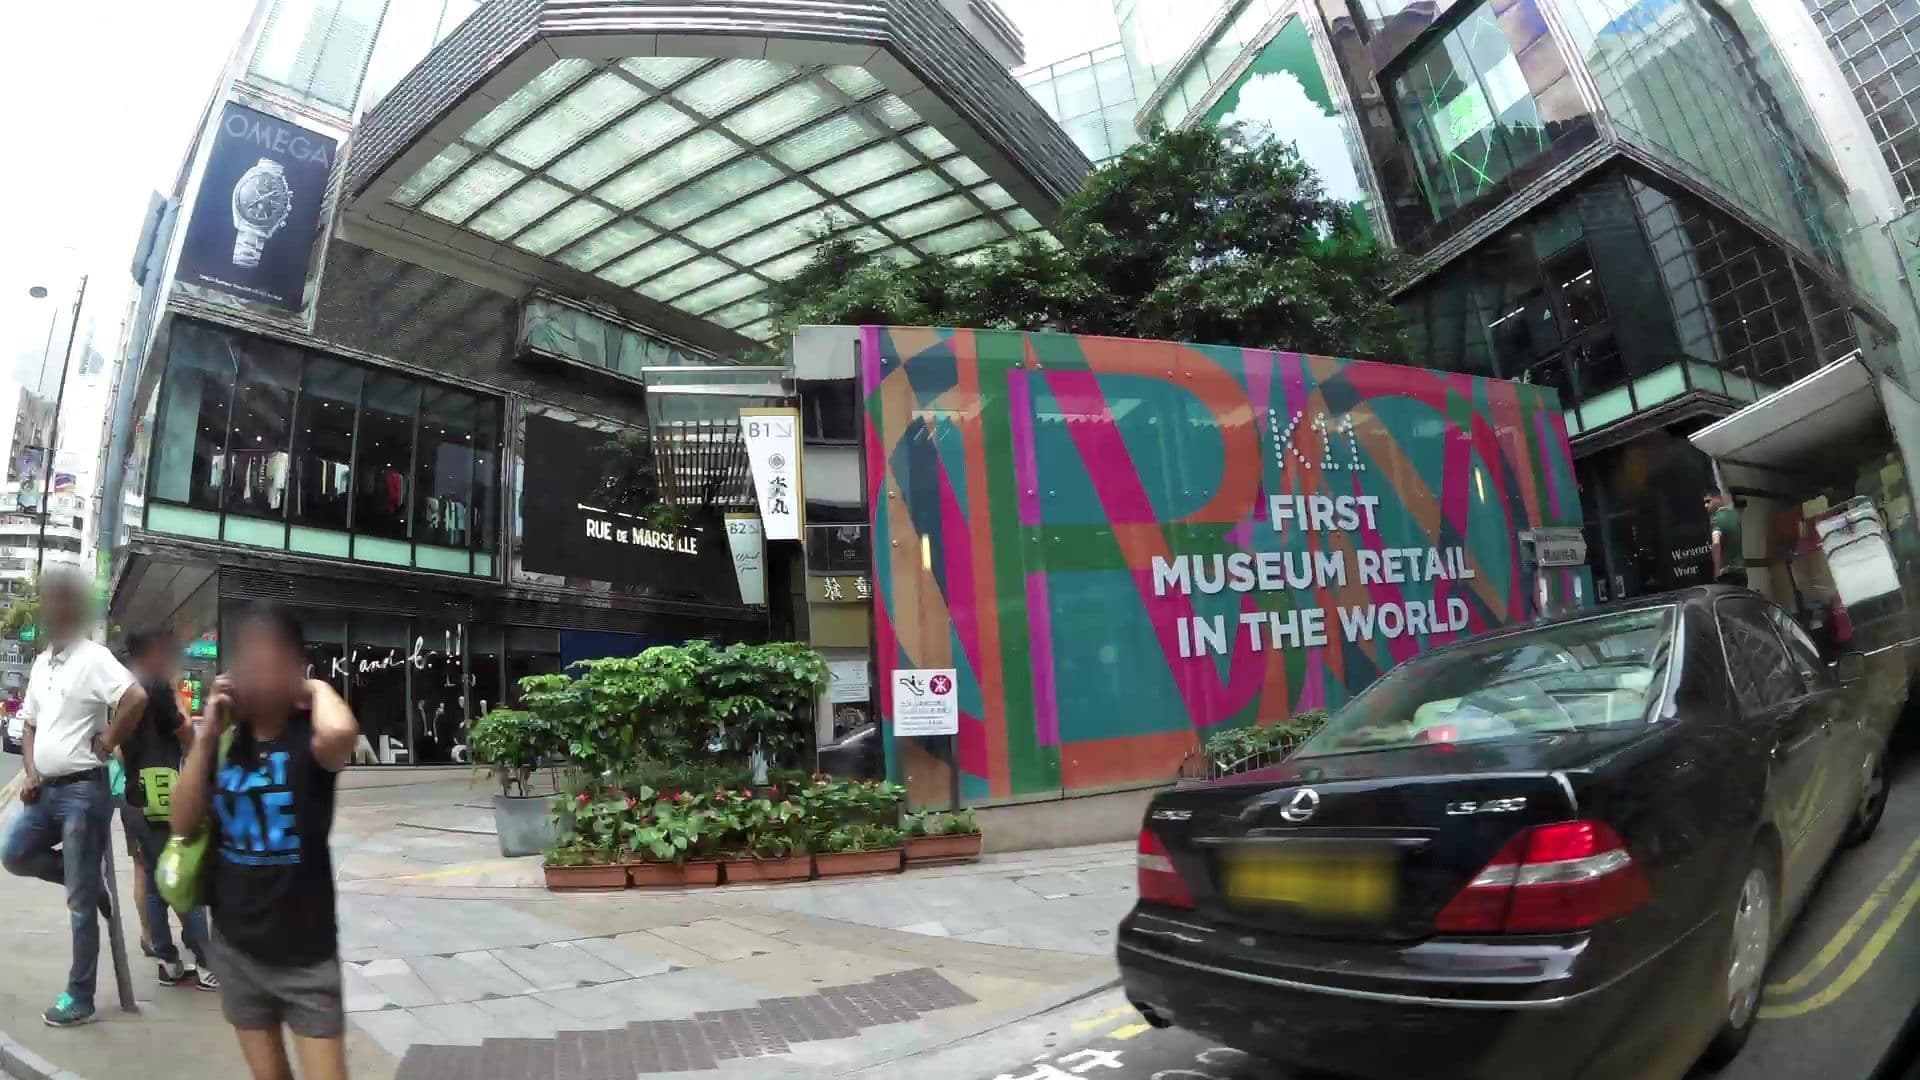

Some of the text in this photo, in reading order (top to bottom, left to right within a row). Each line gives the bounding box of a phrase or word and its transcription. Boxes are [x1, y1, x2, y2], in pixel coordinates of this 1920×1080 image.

[226, 114, 329, 169] OMEGA
[749, 422, 770, 438] B1
[1268, 408, 1367, 471] K11
[586, 518, 613, 541] RUE
[730, 522, 746, 535] B2
[1269, 494, 1380, 532] FIRST
[1152, 546, 1477, 597] MUSEUM RETAIL
[1176, 597, 1470, 658] IN THE WORLD
